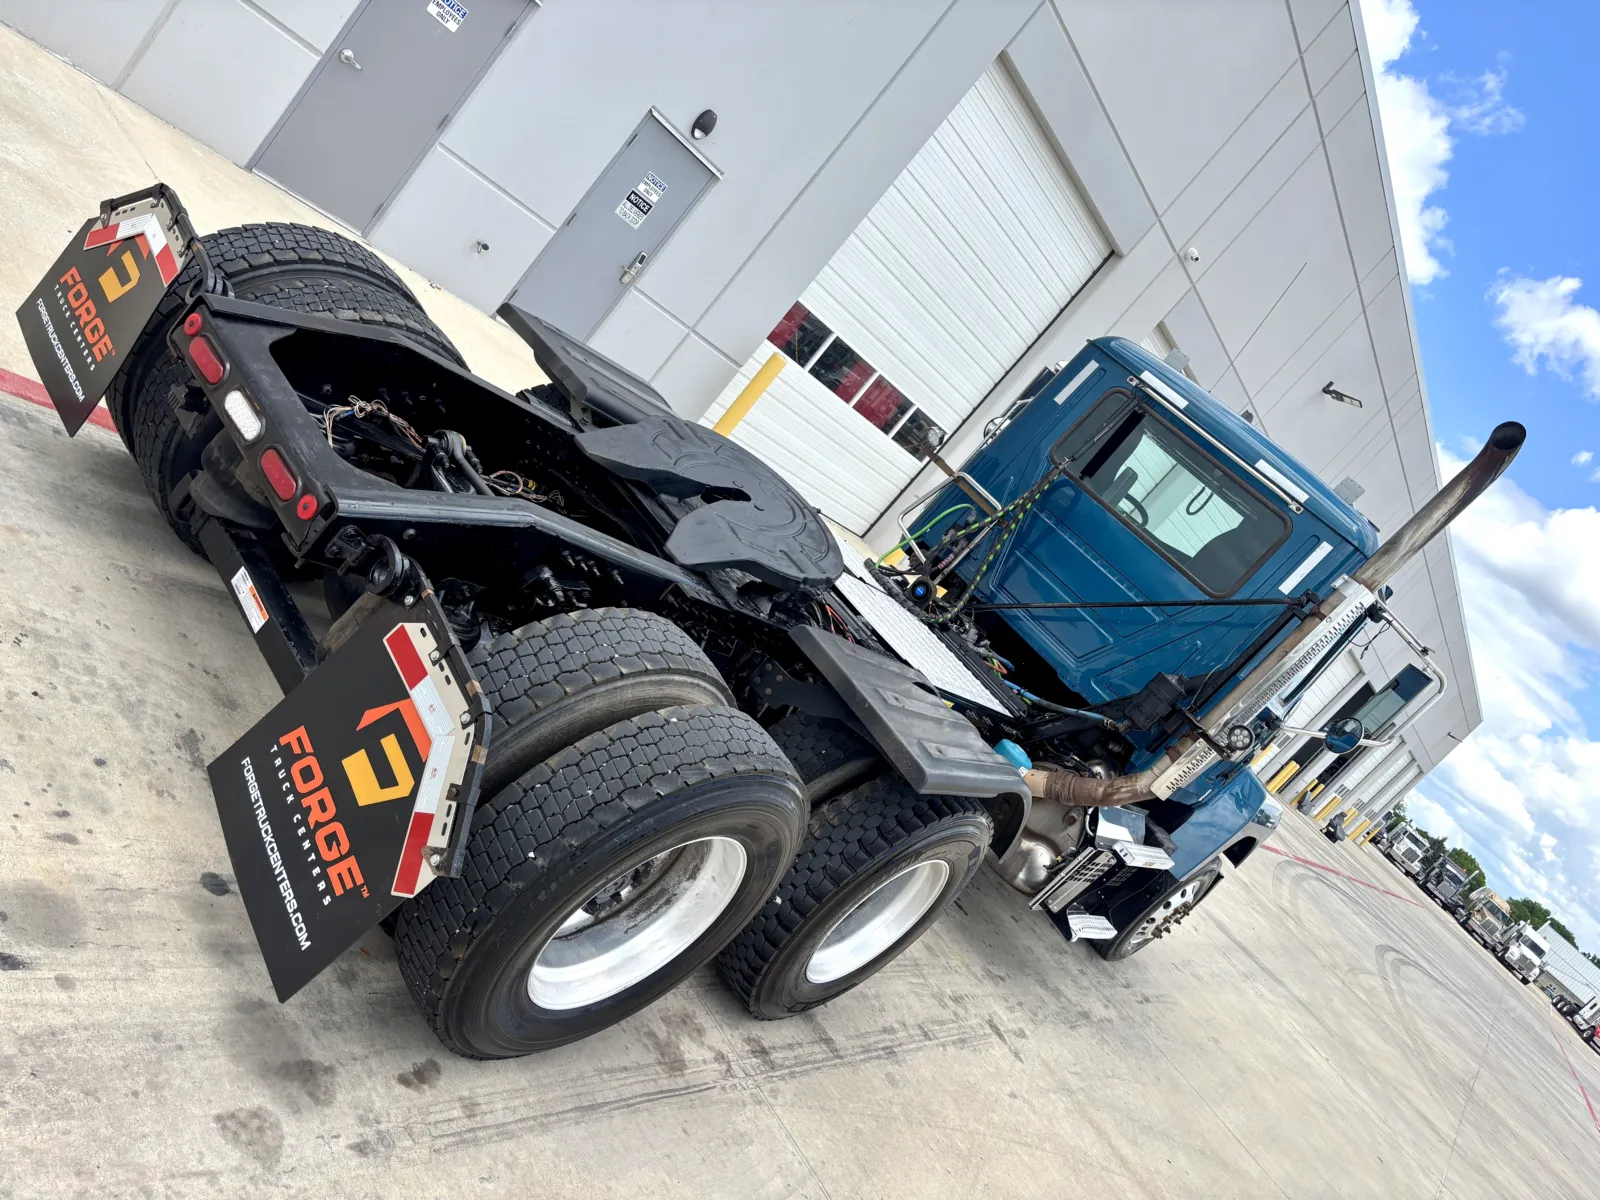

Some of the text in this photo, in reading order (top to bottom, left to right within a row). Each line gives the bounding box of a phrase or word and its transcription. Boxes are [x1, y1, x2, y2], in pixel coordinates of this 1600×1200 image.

[432, 0, 462, 25] EMPLOYEES
[436, 11, 450, 24] ONLY
[642, 180, 662, 197] EMPLOYEES
[643, 187, 653, 197] ONLY
[645, 173, 666, 193] NOTICE
[629, 192, 650, 212] NOTICE
[54, 284, 96, 372] TRUCK CENTERS
[36, 298, 86, 402] FORGETRUCKCENTERS.COM
[271, 744, 332, 906] TRUCK CENTERS
[241, 756, 312, 951] FORGETRUCKCENTERS.COM
